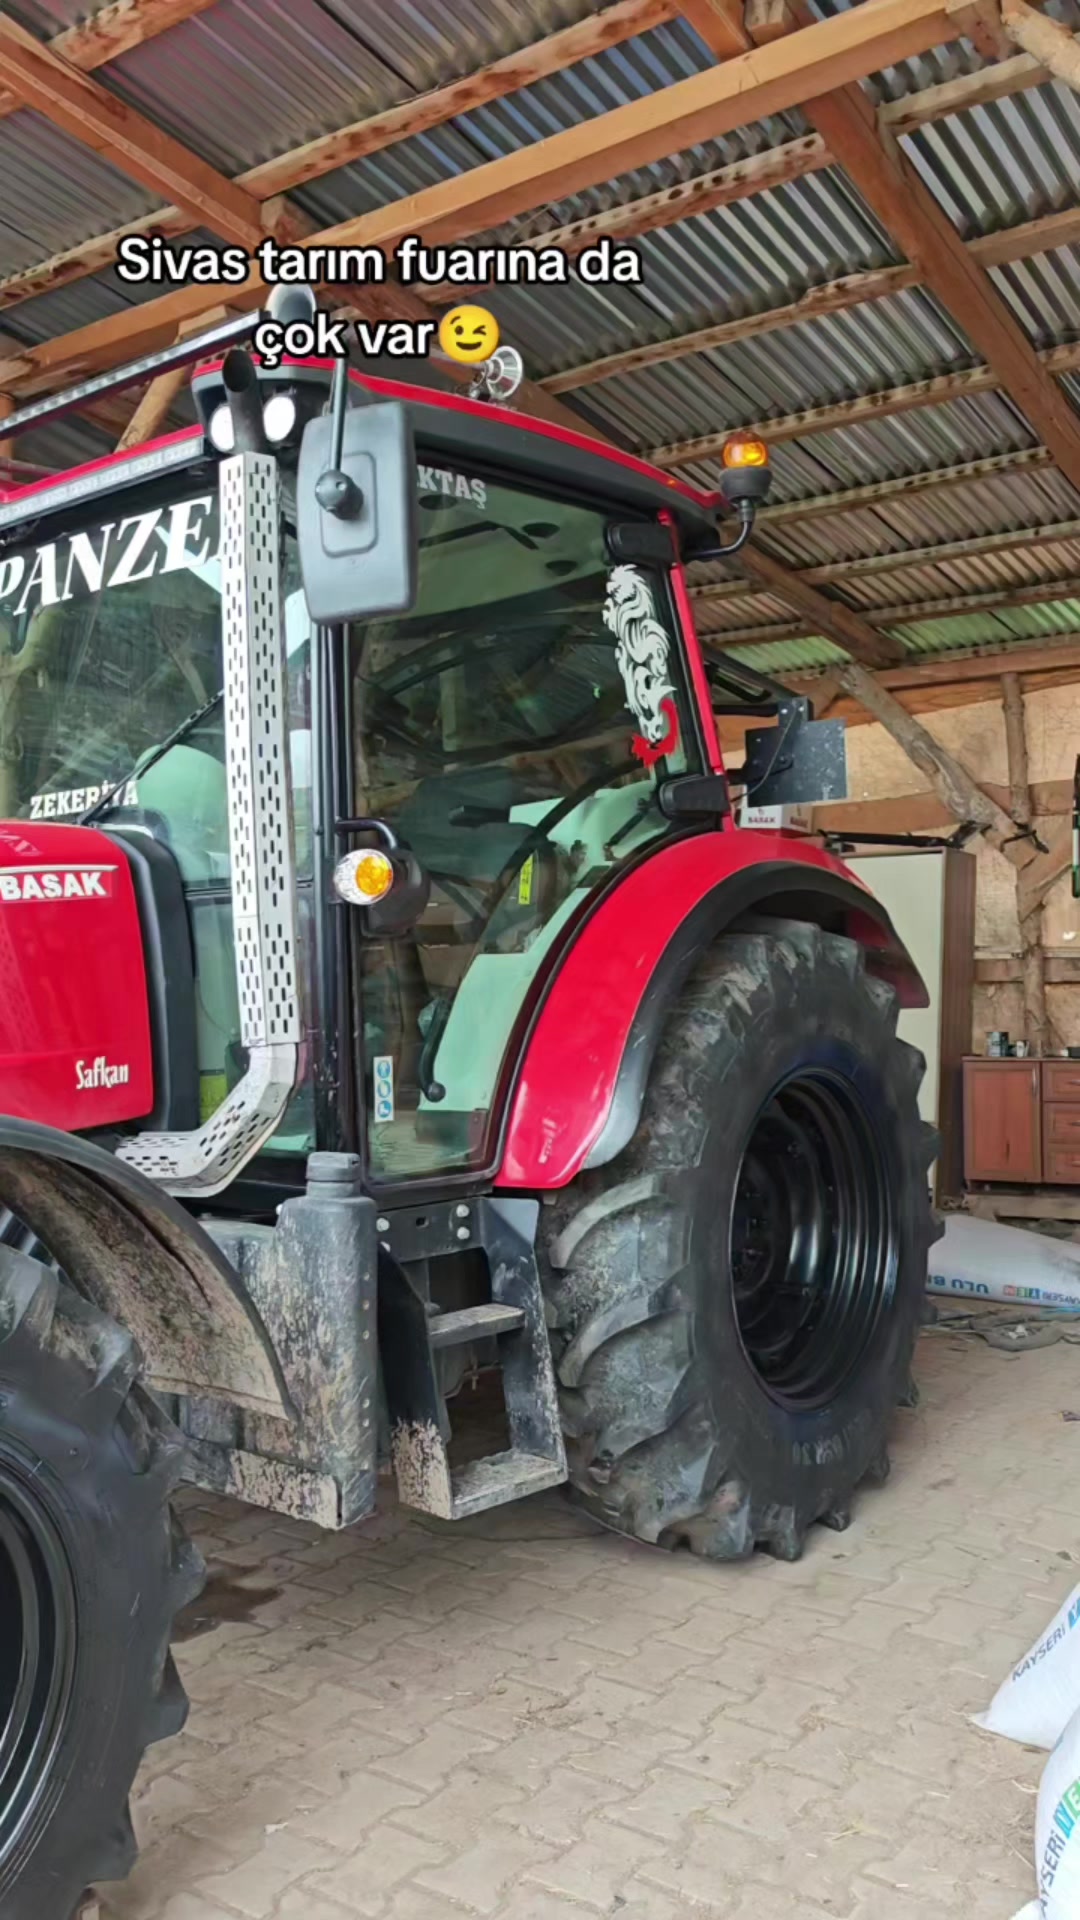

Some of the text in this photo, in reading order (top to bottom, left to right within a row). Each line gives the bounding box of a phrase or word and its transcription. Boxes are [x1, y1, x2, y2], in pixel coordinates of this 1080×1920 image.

[0, 496, 222, 616] PANZE
[0, 871, 108, 901] BASAK
[75, 1055, 129, 1090] Safkan
[951, 1278, 989, 1294] ULU
